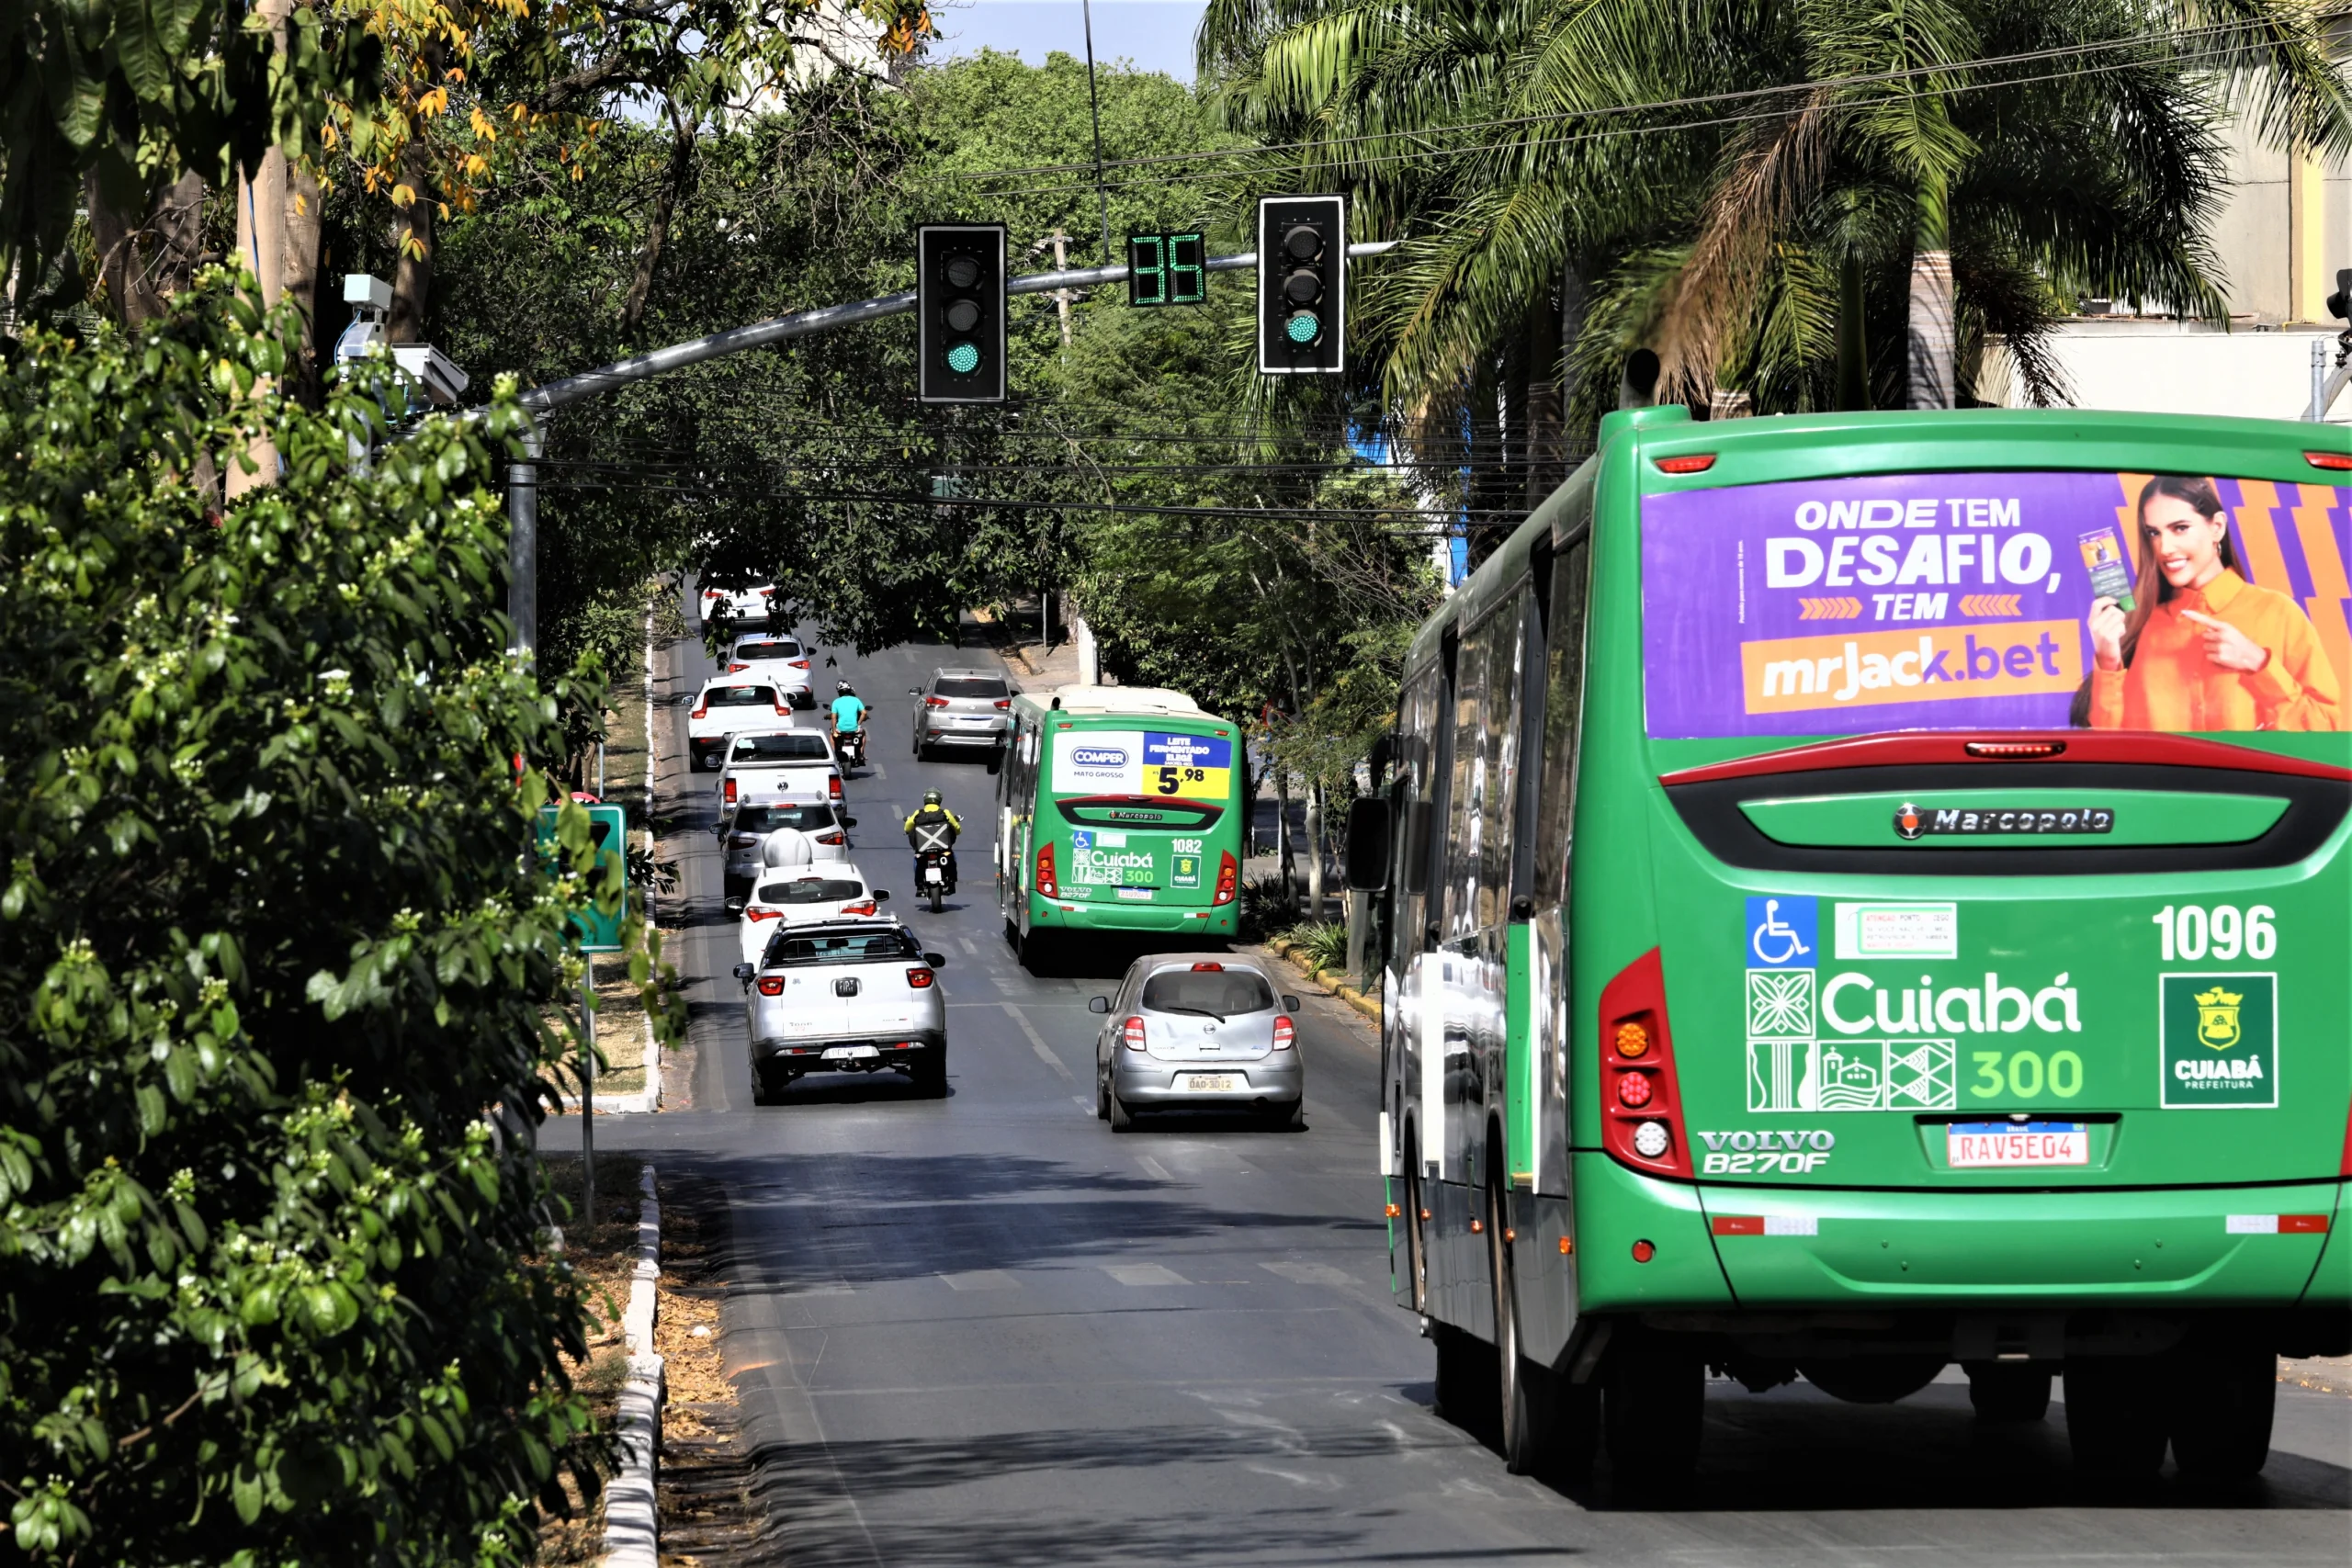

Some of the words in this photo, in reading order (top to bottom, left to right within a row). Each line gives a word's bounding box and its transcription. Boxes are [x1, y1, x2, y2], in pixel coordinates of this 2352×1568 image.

[1132, 234, 1203, 304] 35
[1794, 499, 1939, 531] ONDE
[1945, 498, 2020, 527] TEM
[1766, 532, 2061, 594] DESAFIO,
[1871, 592, 1949, 621] TEM
[1149, 745, 1210, 755] FERMENTADO
[1167, 738, 1191, 746] LEITE
[1074, 751, 1124, 763] COMPER
[1095, 771, 1124, 779] GROSSO
[1933, 808, 2110, 833] Marcopolo
[1171, 838, 1202, 853] 1082
[1091, 851, 1153, 868] Cuiabá
[1125, 871, 1154, 883] 300
[2152, 905, 2278, 961] 1096
[1821, 971, 2082, 1034] Cuiabá
[1970, 1050, 2083, 1098] 300
[2174, 1055, 2264, 1080] CUIABÁ
[2185, 1080, 2254, 1089] PREFEITURA
[1697, 1130, 1836, 1151] VOLVO
[1702, 1153, 1830, 1174] B270F
